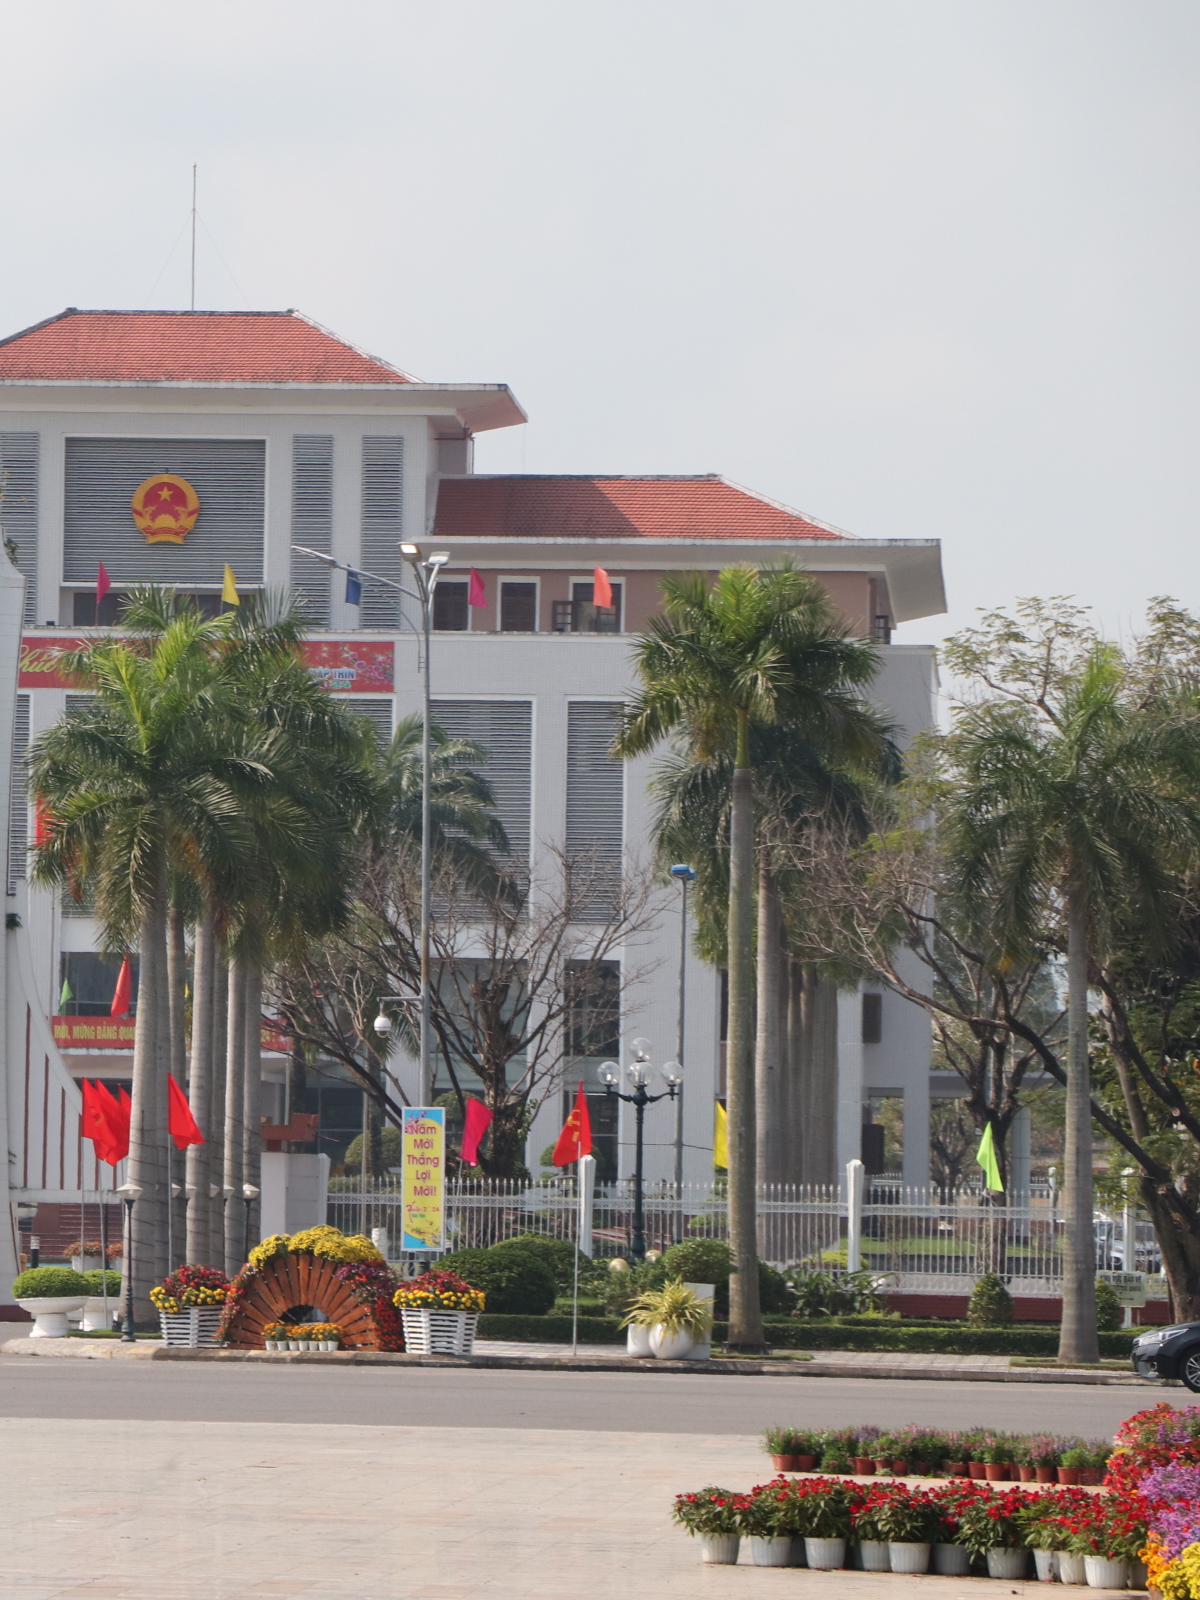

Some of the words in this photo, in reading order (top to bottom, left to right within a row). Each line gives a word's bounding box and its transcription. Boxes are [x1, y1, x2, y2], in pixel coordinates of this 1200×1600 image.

[410, 1124, 437, 1135] Năm
[413, 1138, 434, 1149] Mới
[407, 1152, 440, 1167] Thắng
[415, 1169, 431, 1182] Lợi
[413, 1185, 437, 1197] Mới!
